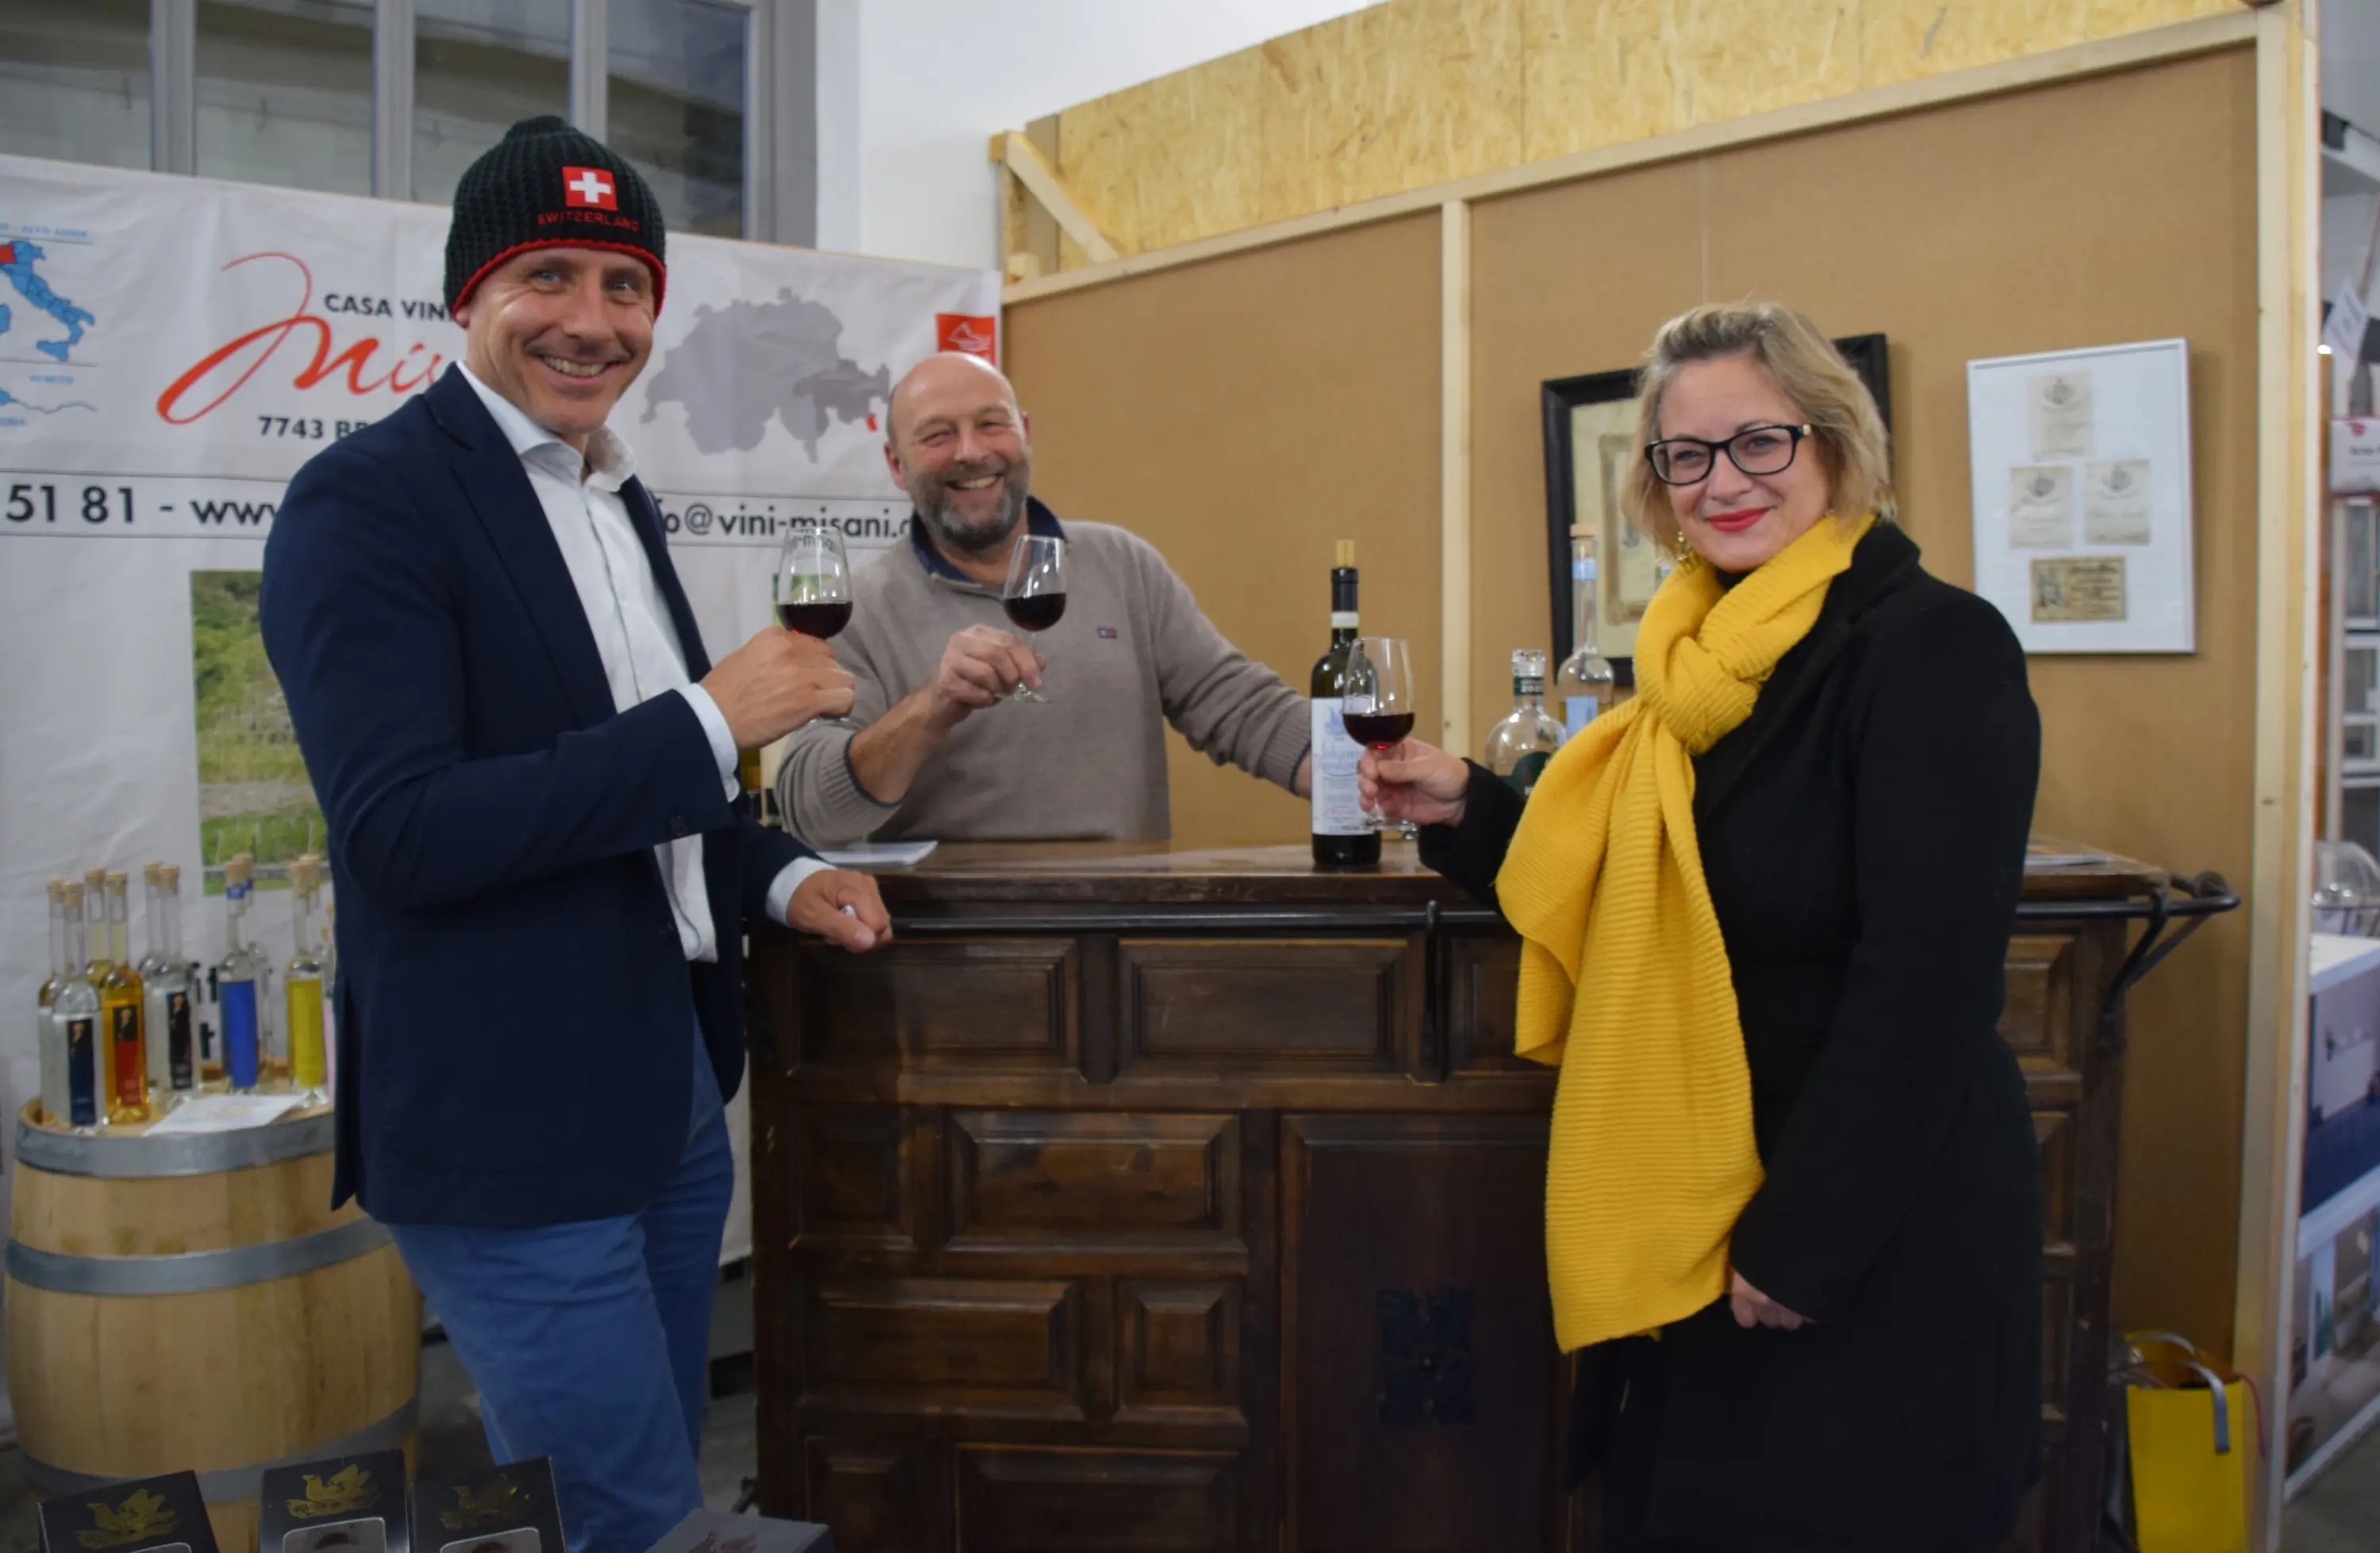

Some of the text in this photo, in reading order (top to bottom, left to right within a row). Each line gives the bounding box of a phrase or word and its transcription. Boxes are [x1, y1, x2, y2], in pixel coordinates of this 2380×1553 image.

[537, 210, 640, 232] SWITZERLAND
[324, 293, 453, 322] CASA VIN
[258, 415, 324, 439] 7743
[6, 484, 56, 523] 51
[81, 485, 134, 524] 81
[657, 497, 912, 539] o@vini-misani.
